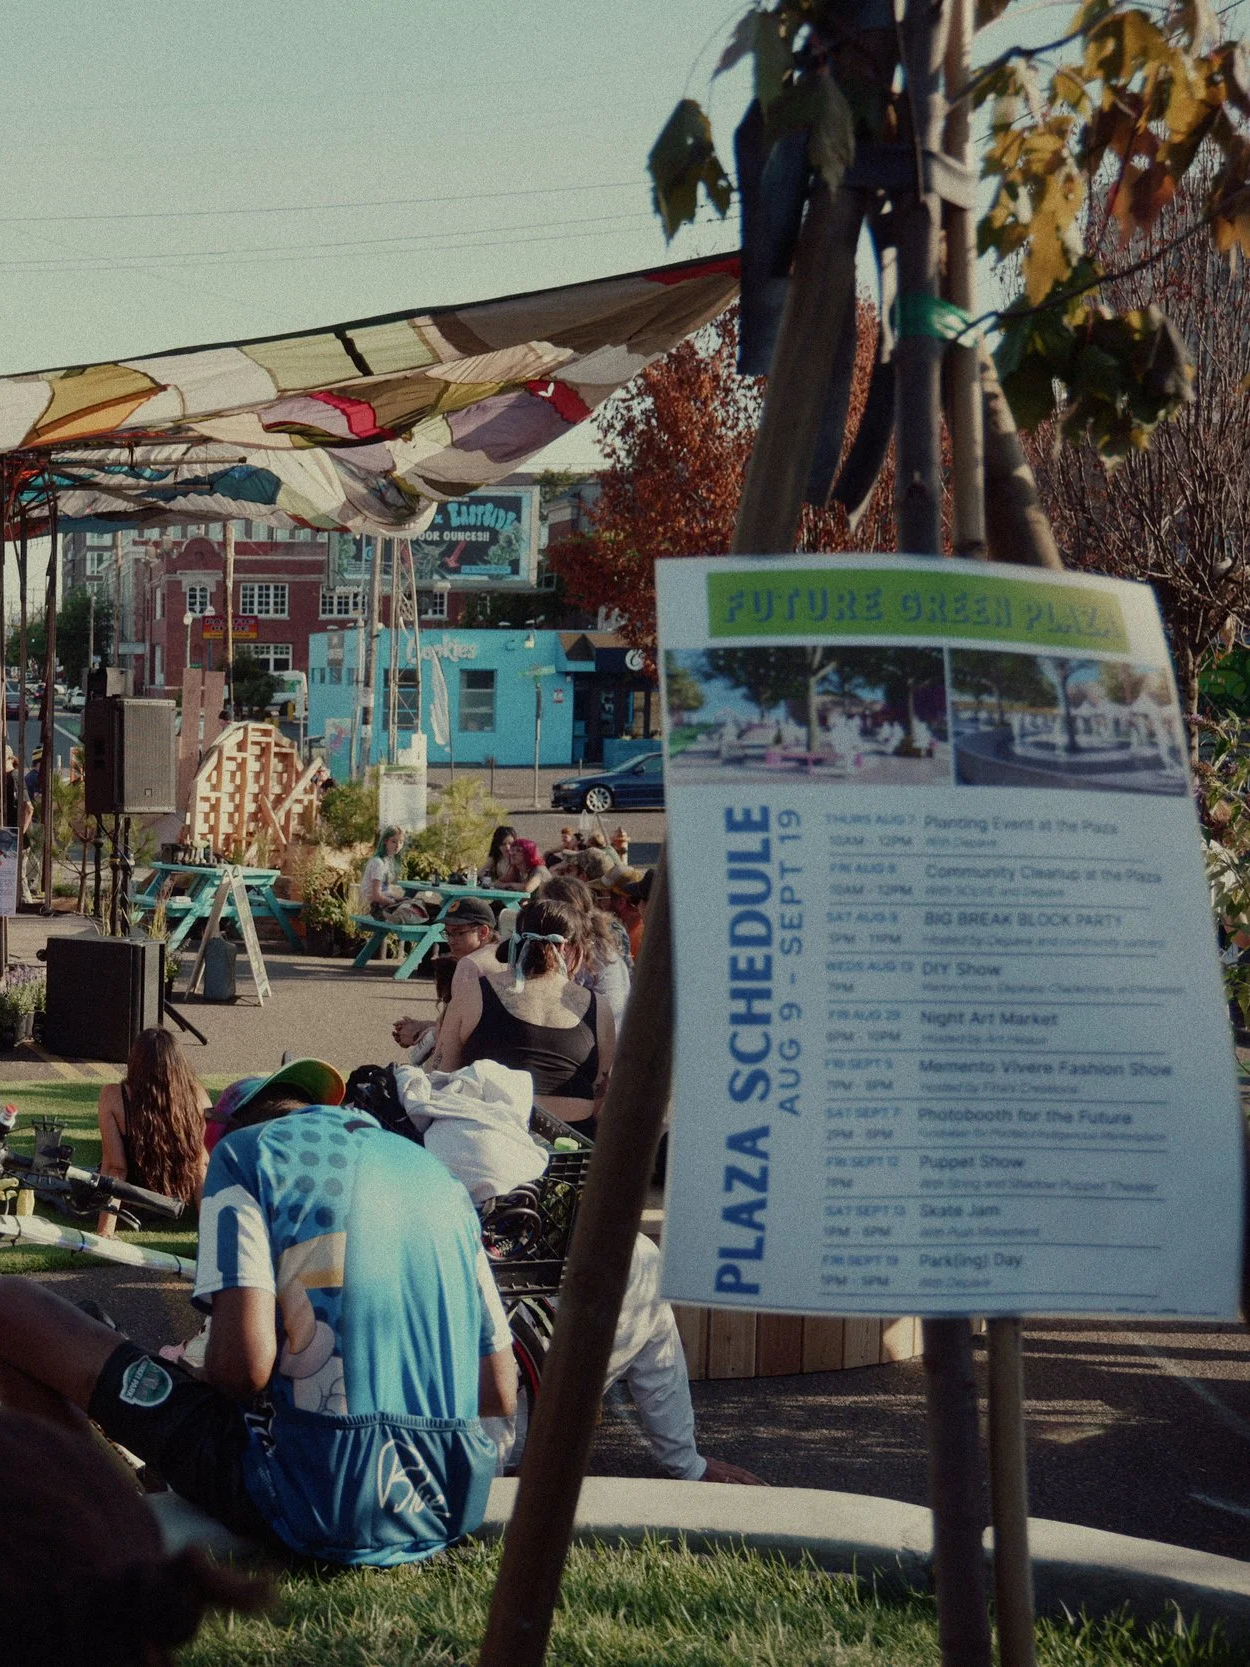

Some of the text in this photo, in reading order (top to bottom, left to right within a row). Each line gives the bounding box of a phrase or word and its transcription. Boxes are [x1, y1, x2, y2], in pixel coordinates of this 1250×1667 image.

[443, 531, 490, 541] OUNCES!!
[723, 585, 1124, 639] FUTURE GREEN PLAZA
[777, 808, 803, 844] 19
[924, 814, 988, 833] Planting
[992, 815, 1035, 831] Event
[925, 863, 1015, 882] Community
[778, 859, 804, 957] SEPT
[924, 911, 1122, 927] BIG BREAK BLOCK PARTY
[956, 961, 1002, 977] Show
[779, 1001, 803, 1022] 9
[920, 1010, 1059, 1028] Night Art Market
[714, 805, 775, 1296] PLAZA SCHEDULE
[919, 1059, 1172, 1077] Memento Vivere Fashion Show
[777, 1037, 803, 1118] AUG
[918, 1107, 1133, 1125] Photobooth for the Future
[920, 1153, 1025, 1171] Puppet Show
[919, 1202, 1001, 1218] Skate Jam
[993, 1252, 1023, 1270] Day
